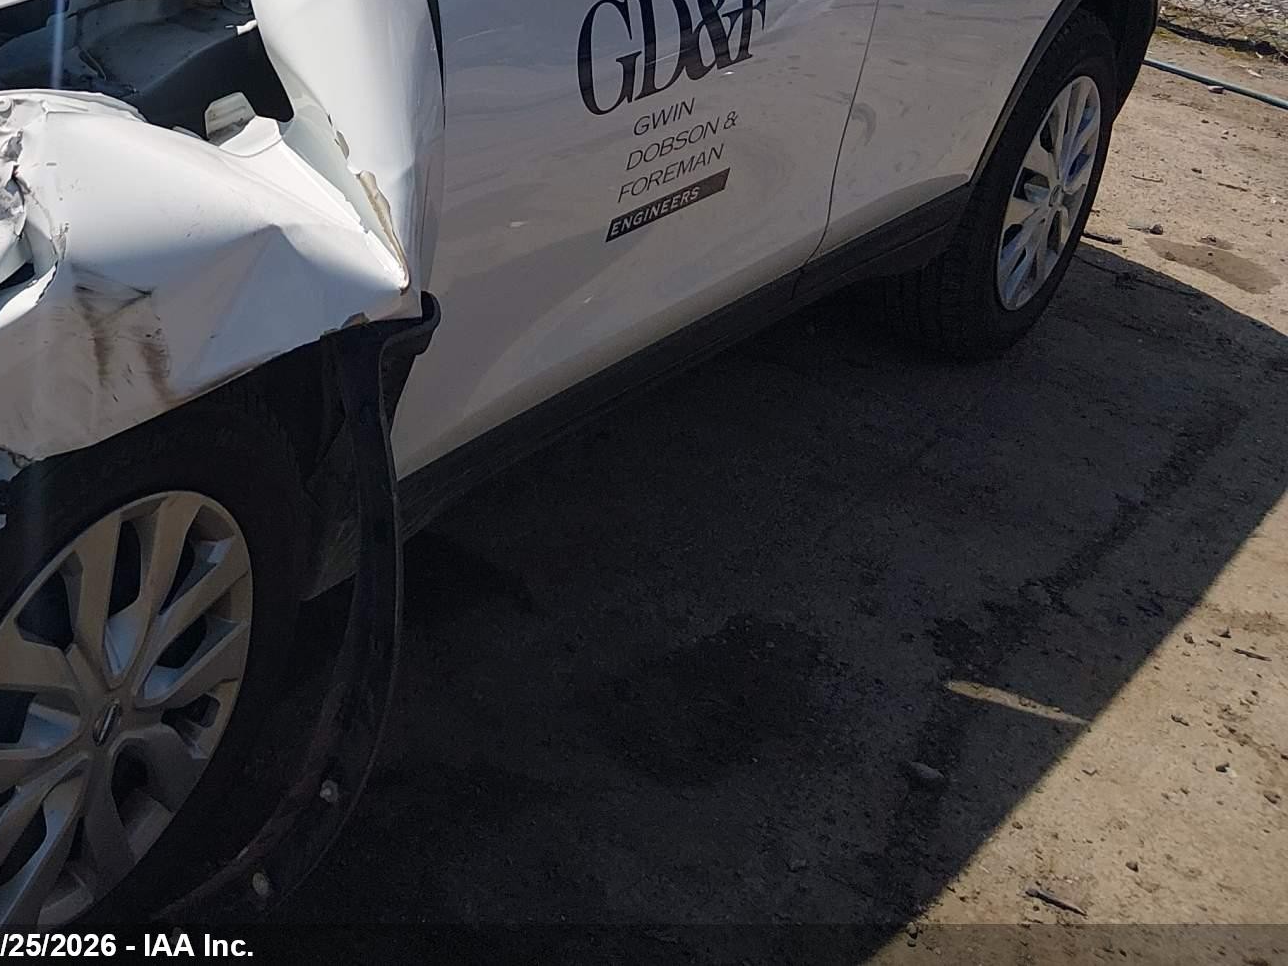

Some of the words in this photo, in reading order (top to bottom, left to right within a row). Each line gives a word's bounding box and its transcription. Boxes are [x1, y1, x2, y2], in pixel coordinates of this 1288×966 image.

[626, 117, 720, 170] DOBSON
[723, 110, 738, 130] &
[633, 97, 695, 135] GWIN
[618, 143, 724, 203] FOREMAN
[611, 186, 700, 235] ENGINEERS
